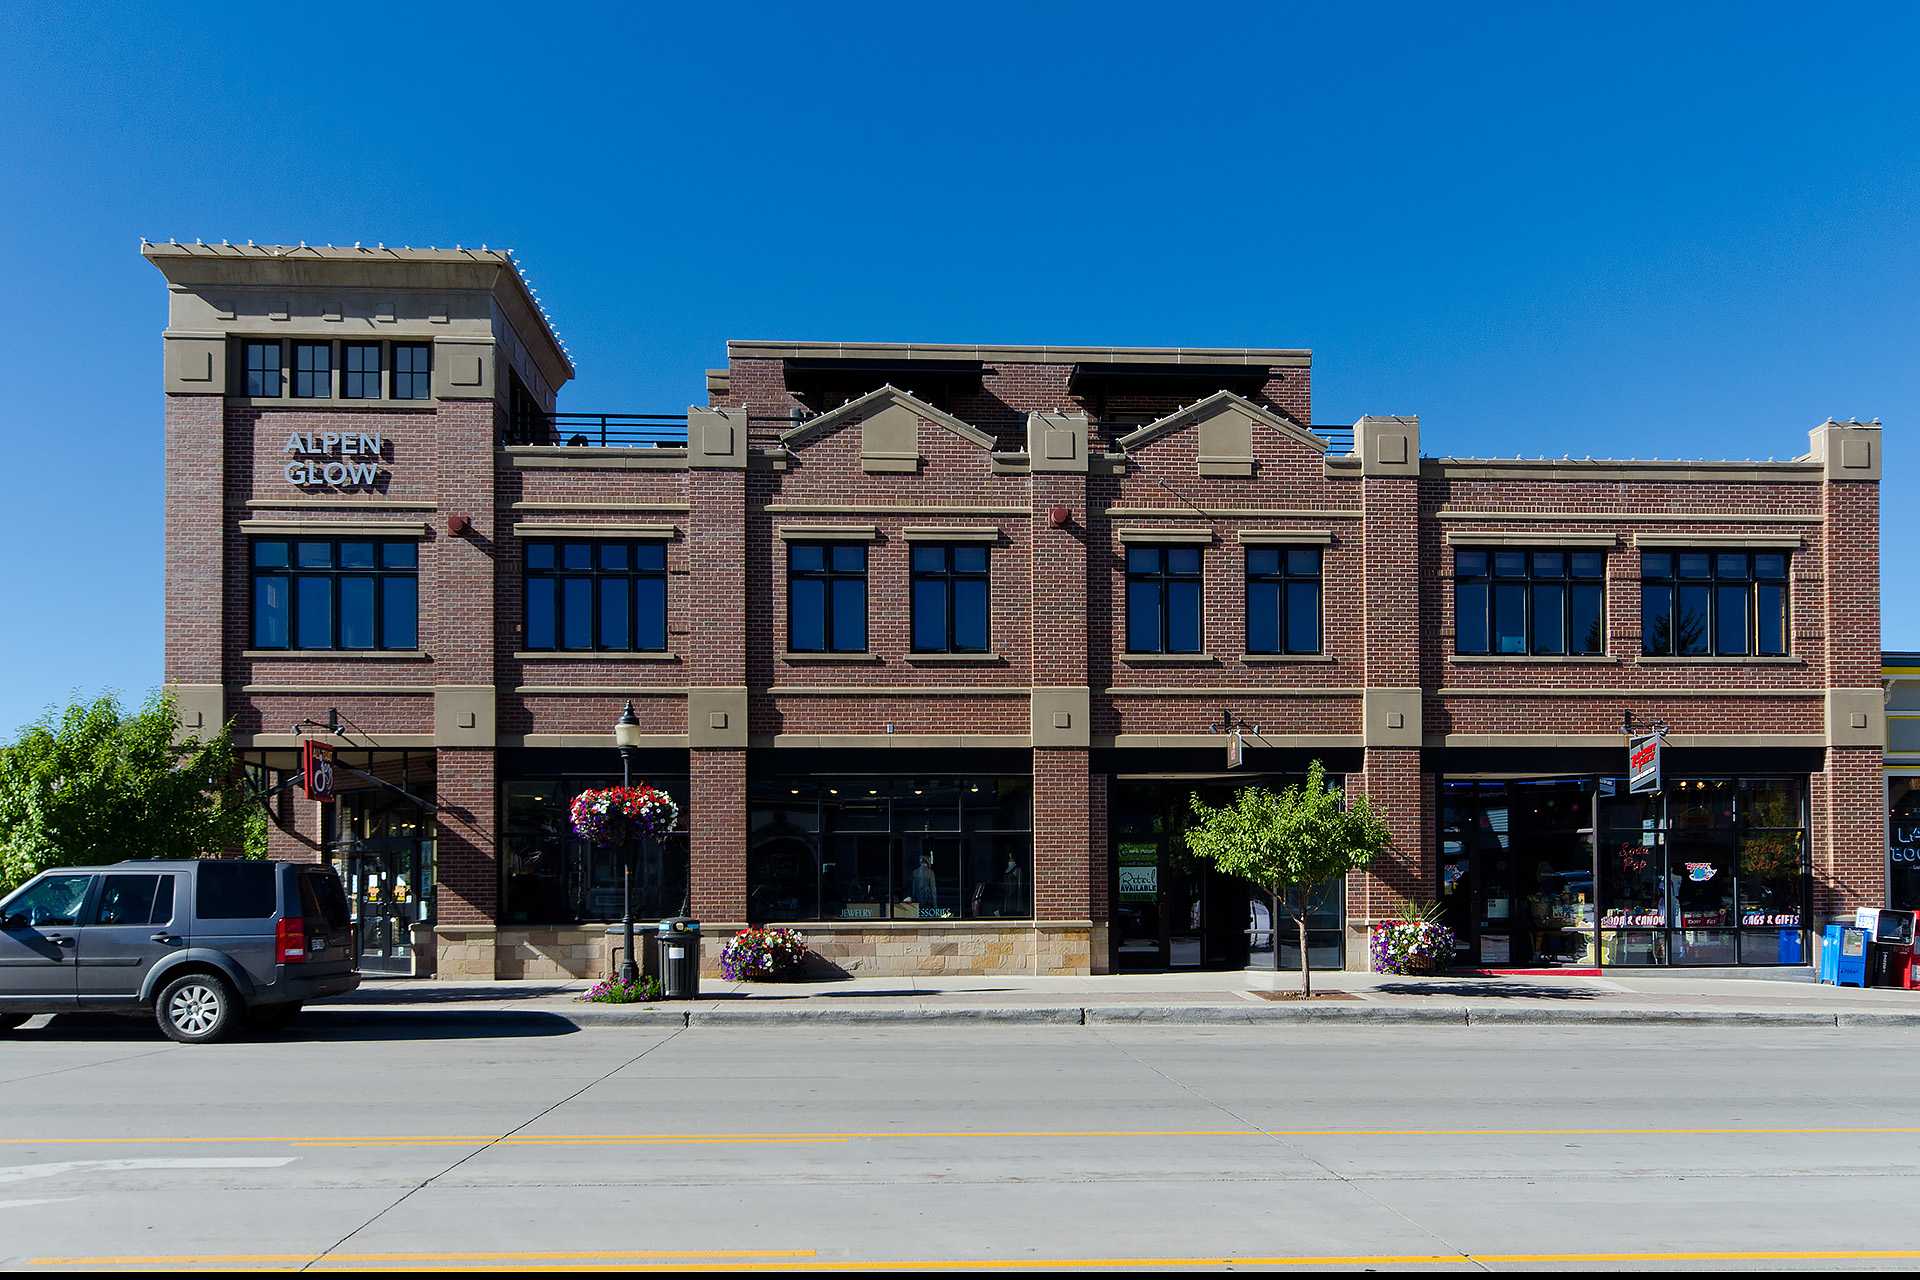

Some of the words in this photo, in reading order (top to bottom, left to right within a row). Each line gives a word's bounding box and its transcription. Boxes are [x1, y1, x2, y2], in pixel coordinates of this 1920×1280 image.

[283, 431, 381, 454] ALPEN
[284, 461, 378, 485] GLOW
[1120, 884, 1157, 892] AVAILABLE
[1742, 915, 1765, 926] GAGS
[1766, 915, 1774, 925] &
[1775, 914, 1800, 925] GIFTS
